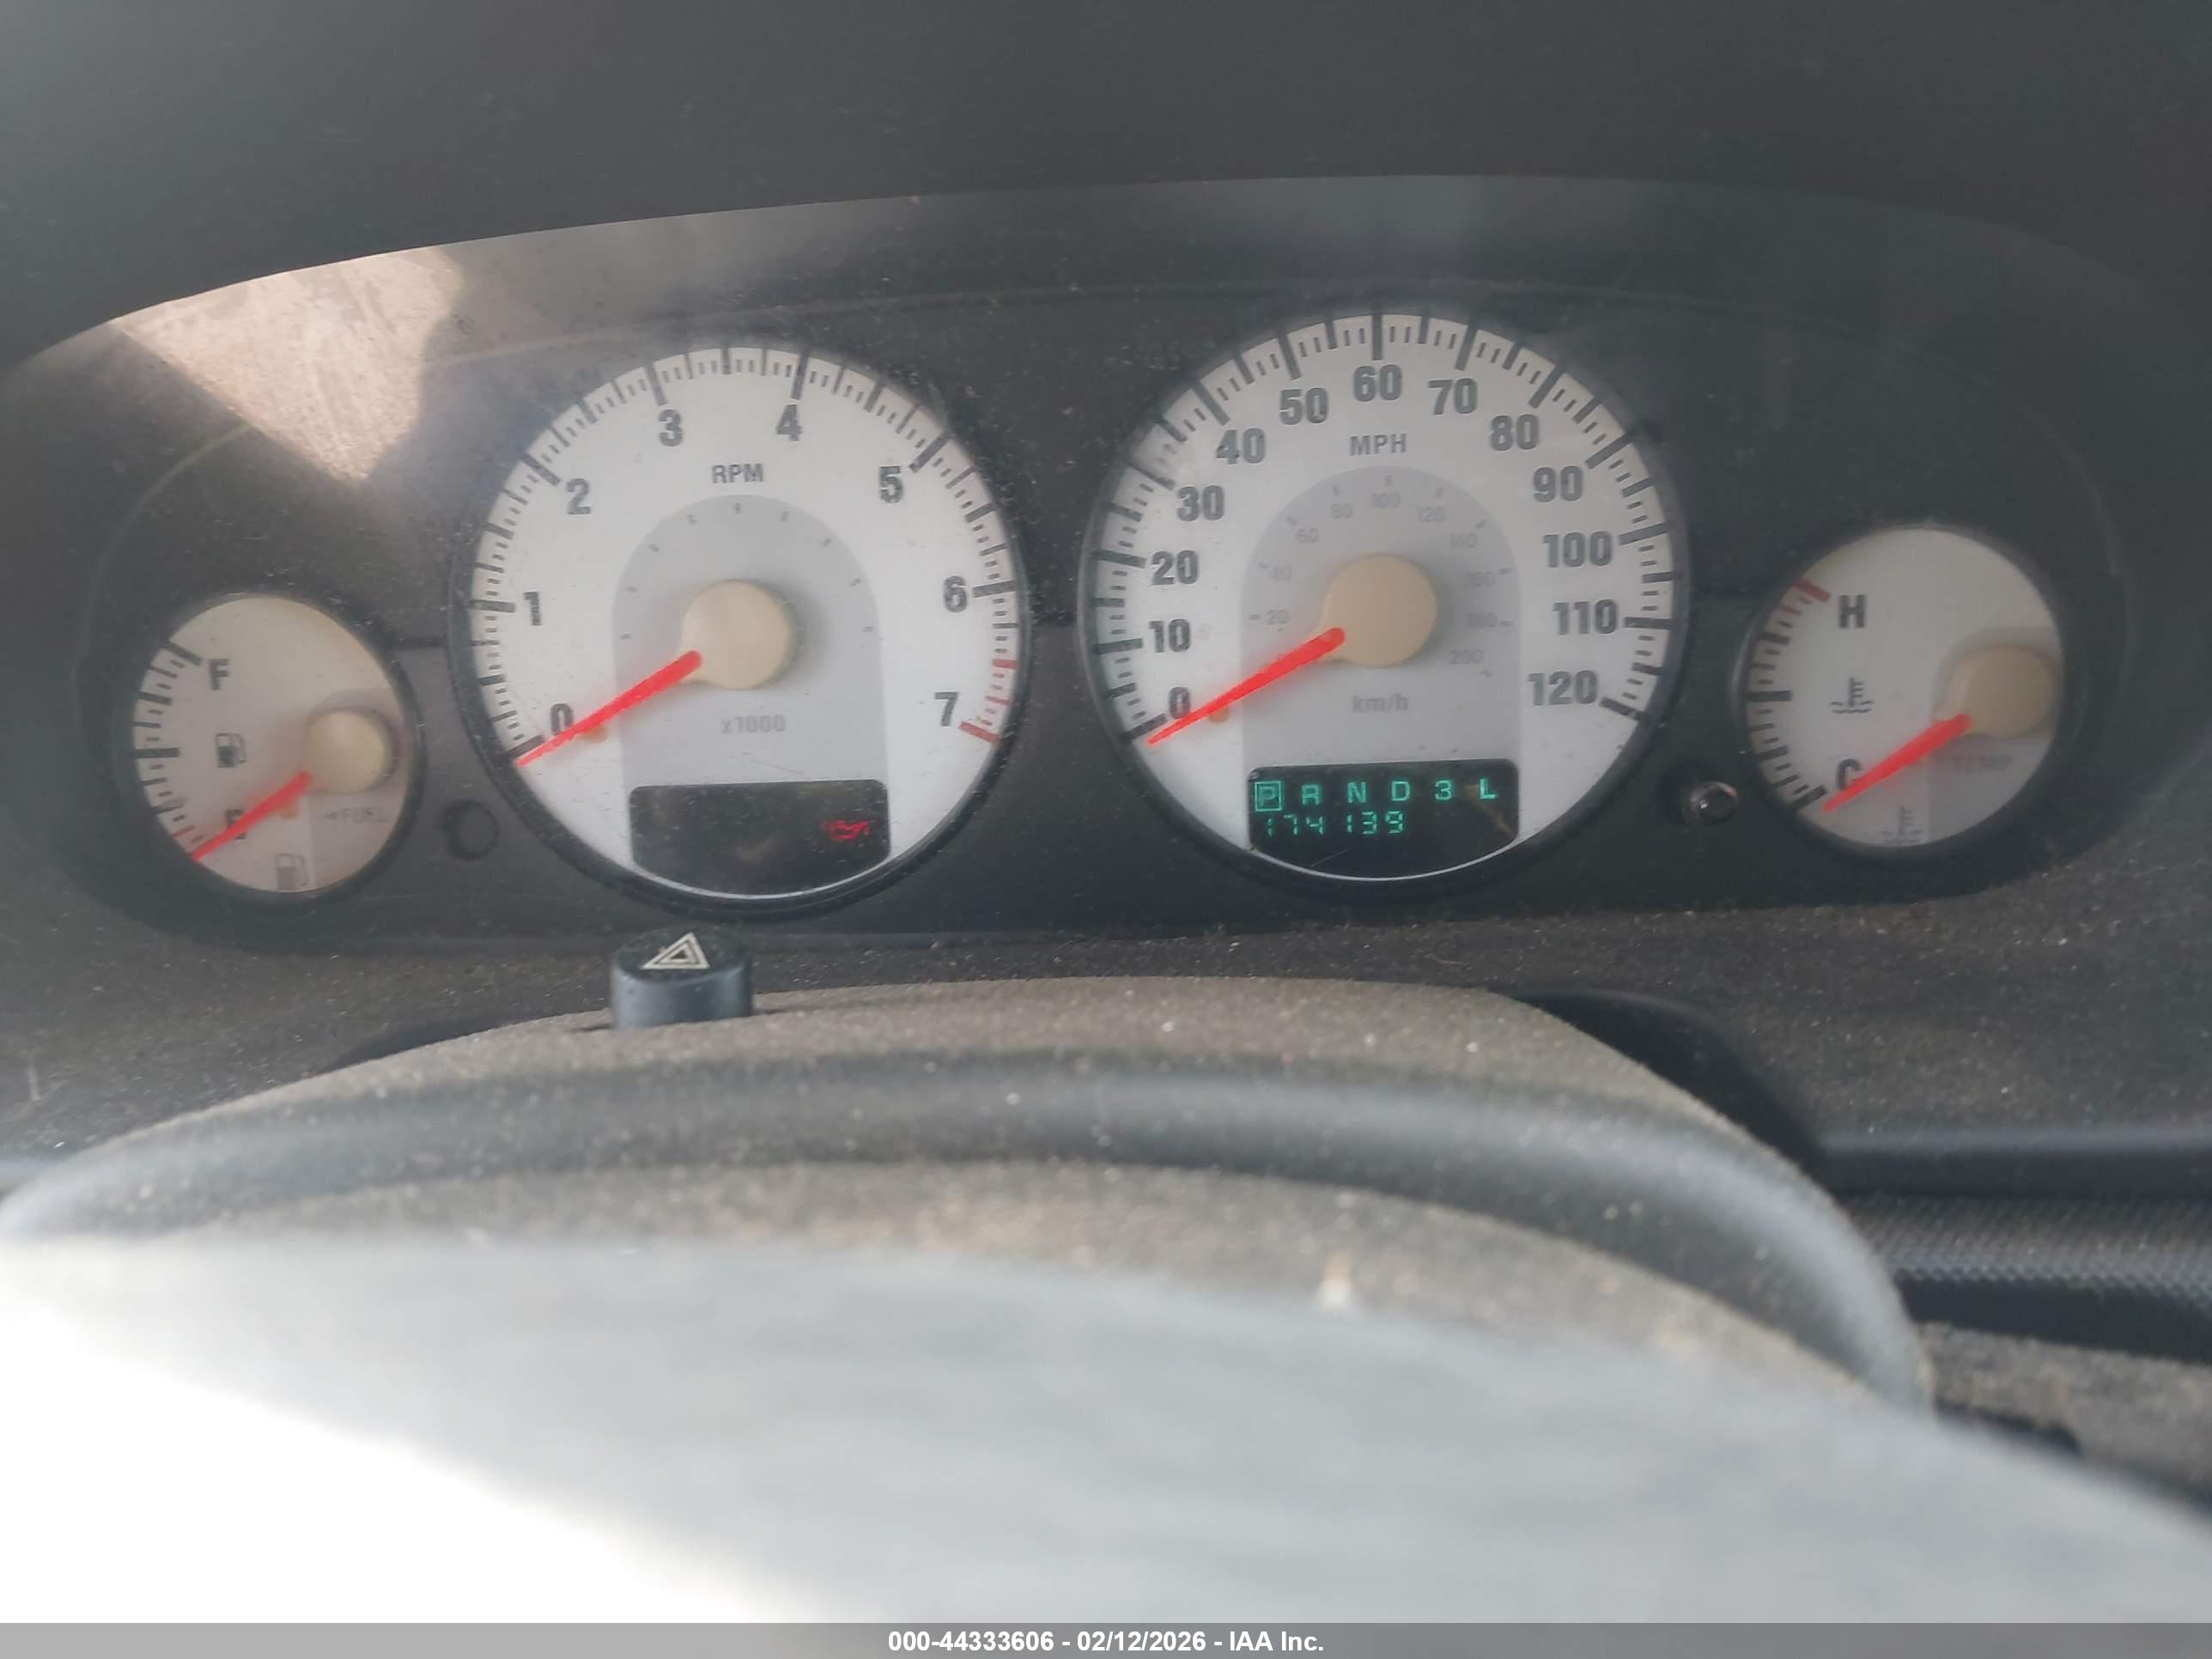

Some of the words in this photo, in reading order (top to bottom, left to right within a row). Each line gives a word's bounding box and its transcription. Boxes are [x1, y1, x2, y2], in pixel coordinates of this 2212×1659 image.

[1353, 365, 1402, 401] 60
[1428, 378, 1478, 415] 70
[776, 405, 802, 441] 4
[1279, 387, 1328, 424] 50
[659, 409, 684, 447] 3
[1350, 434, 1407, 456] MPH
[1490, 415, 1540, 451] 80
[1215, 428, 1266, 465] 40
[712, 463, 764, 483] RPM
[878, 465, 903, 503] 5
[1533, 466, 1583, 502] 90
[567, 478, 591, 515] 2
[1176, 485, 1224, 521] 30
[1542, 531, 1612, 568] 100
[1151, 550, 1199, 585] 20
[524, 592, 542, 625] 1
[944, 576, 969, 612] 6
[1838, 594, 1866, 628] H
[1266, 610, 1290, 625] 20
[1553, 599, 1617, 634] 110
[1150, 619, 1190, 653] 10
[209, 659, 229, 690] F
[1528, 670, 1598, 706] 120
[550, 703, 574, 738] 0
[934, 692, 959, 726] 7
[1169, 686, 1190, 720] 0
[1352, 693, 1409, 713] km/h
[721, 714, 786, 733] x1000
[1257, 785, 1279, 806] P
[1301, 784, 1322, 805] R
[1347, 782, 1367, 803] N
[1391, 781, 1411, 801] D
[1435, 780, 1453, 800] 3
[1480, 778, 1498, 799] L
[1267, 810, 1405, 837] 174139
